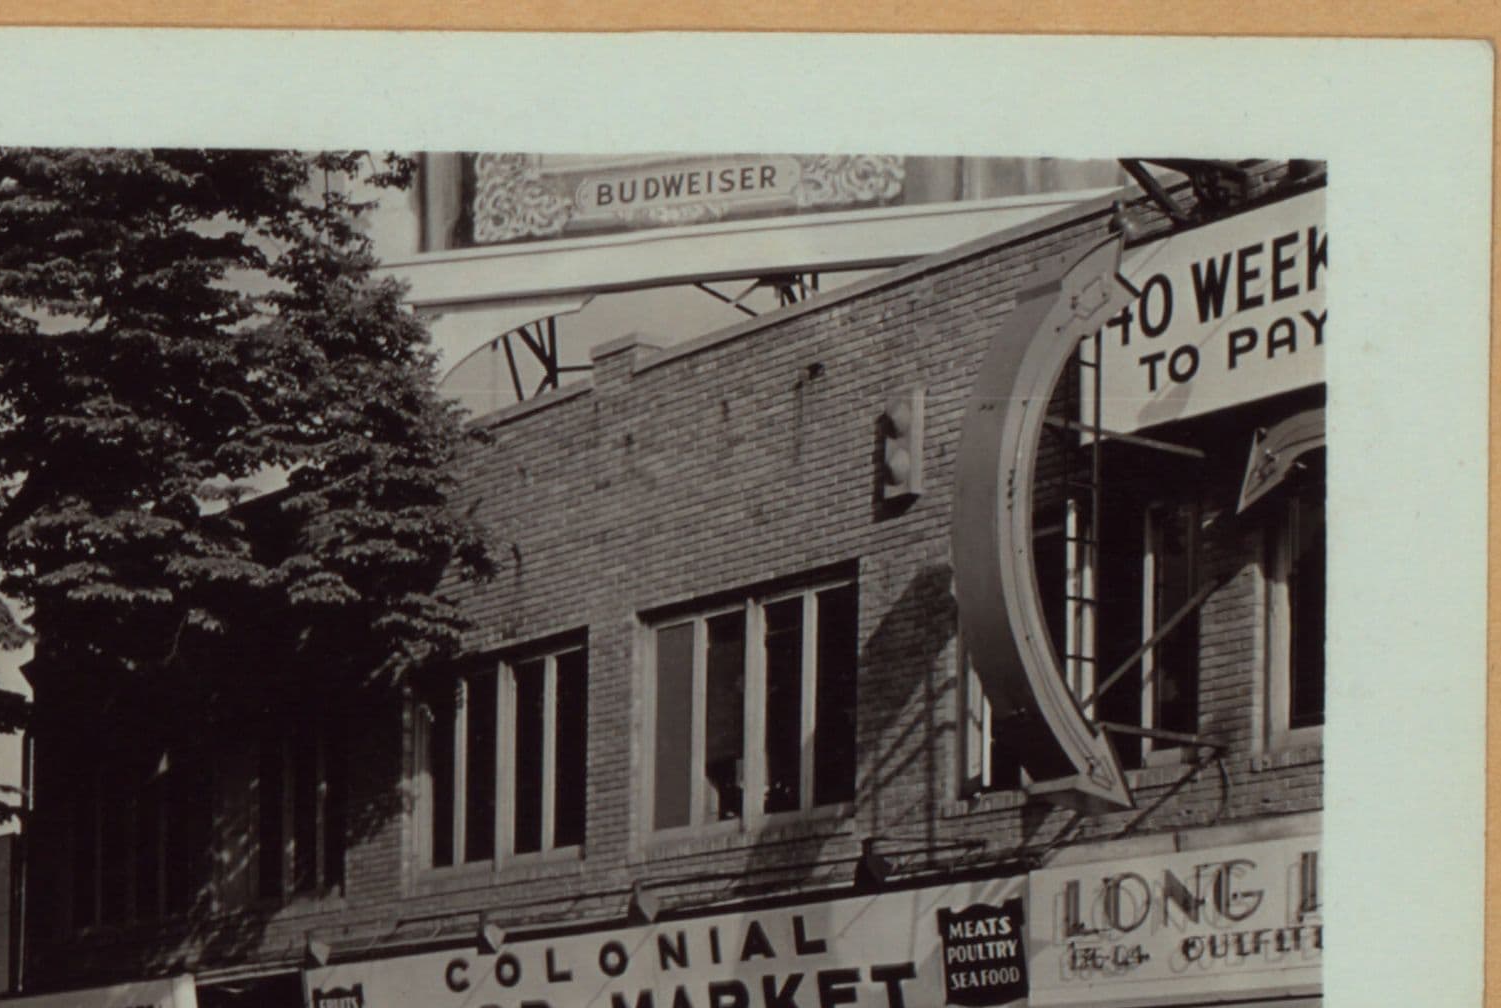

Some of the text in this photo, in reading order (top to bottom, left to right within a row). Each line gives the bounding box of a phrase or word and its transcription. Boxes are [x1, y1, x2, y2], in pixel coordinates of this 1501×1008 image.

[595, 164, 778, 206] BUDWEISER
[1139, 310, 1325, 392] TO PAY
[949, 916, 1012, 940] MEATS
[1062, 858, 1265, 938] LONG
[445, 915, 829, 993] COLONIAL
[947, 939, 1018, 965] POULTRY
